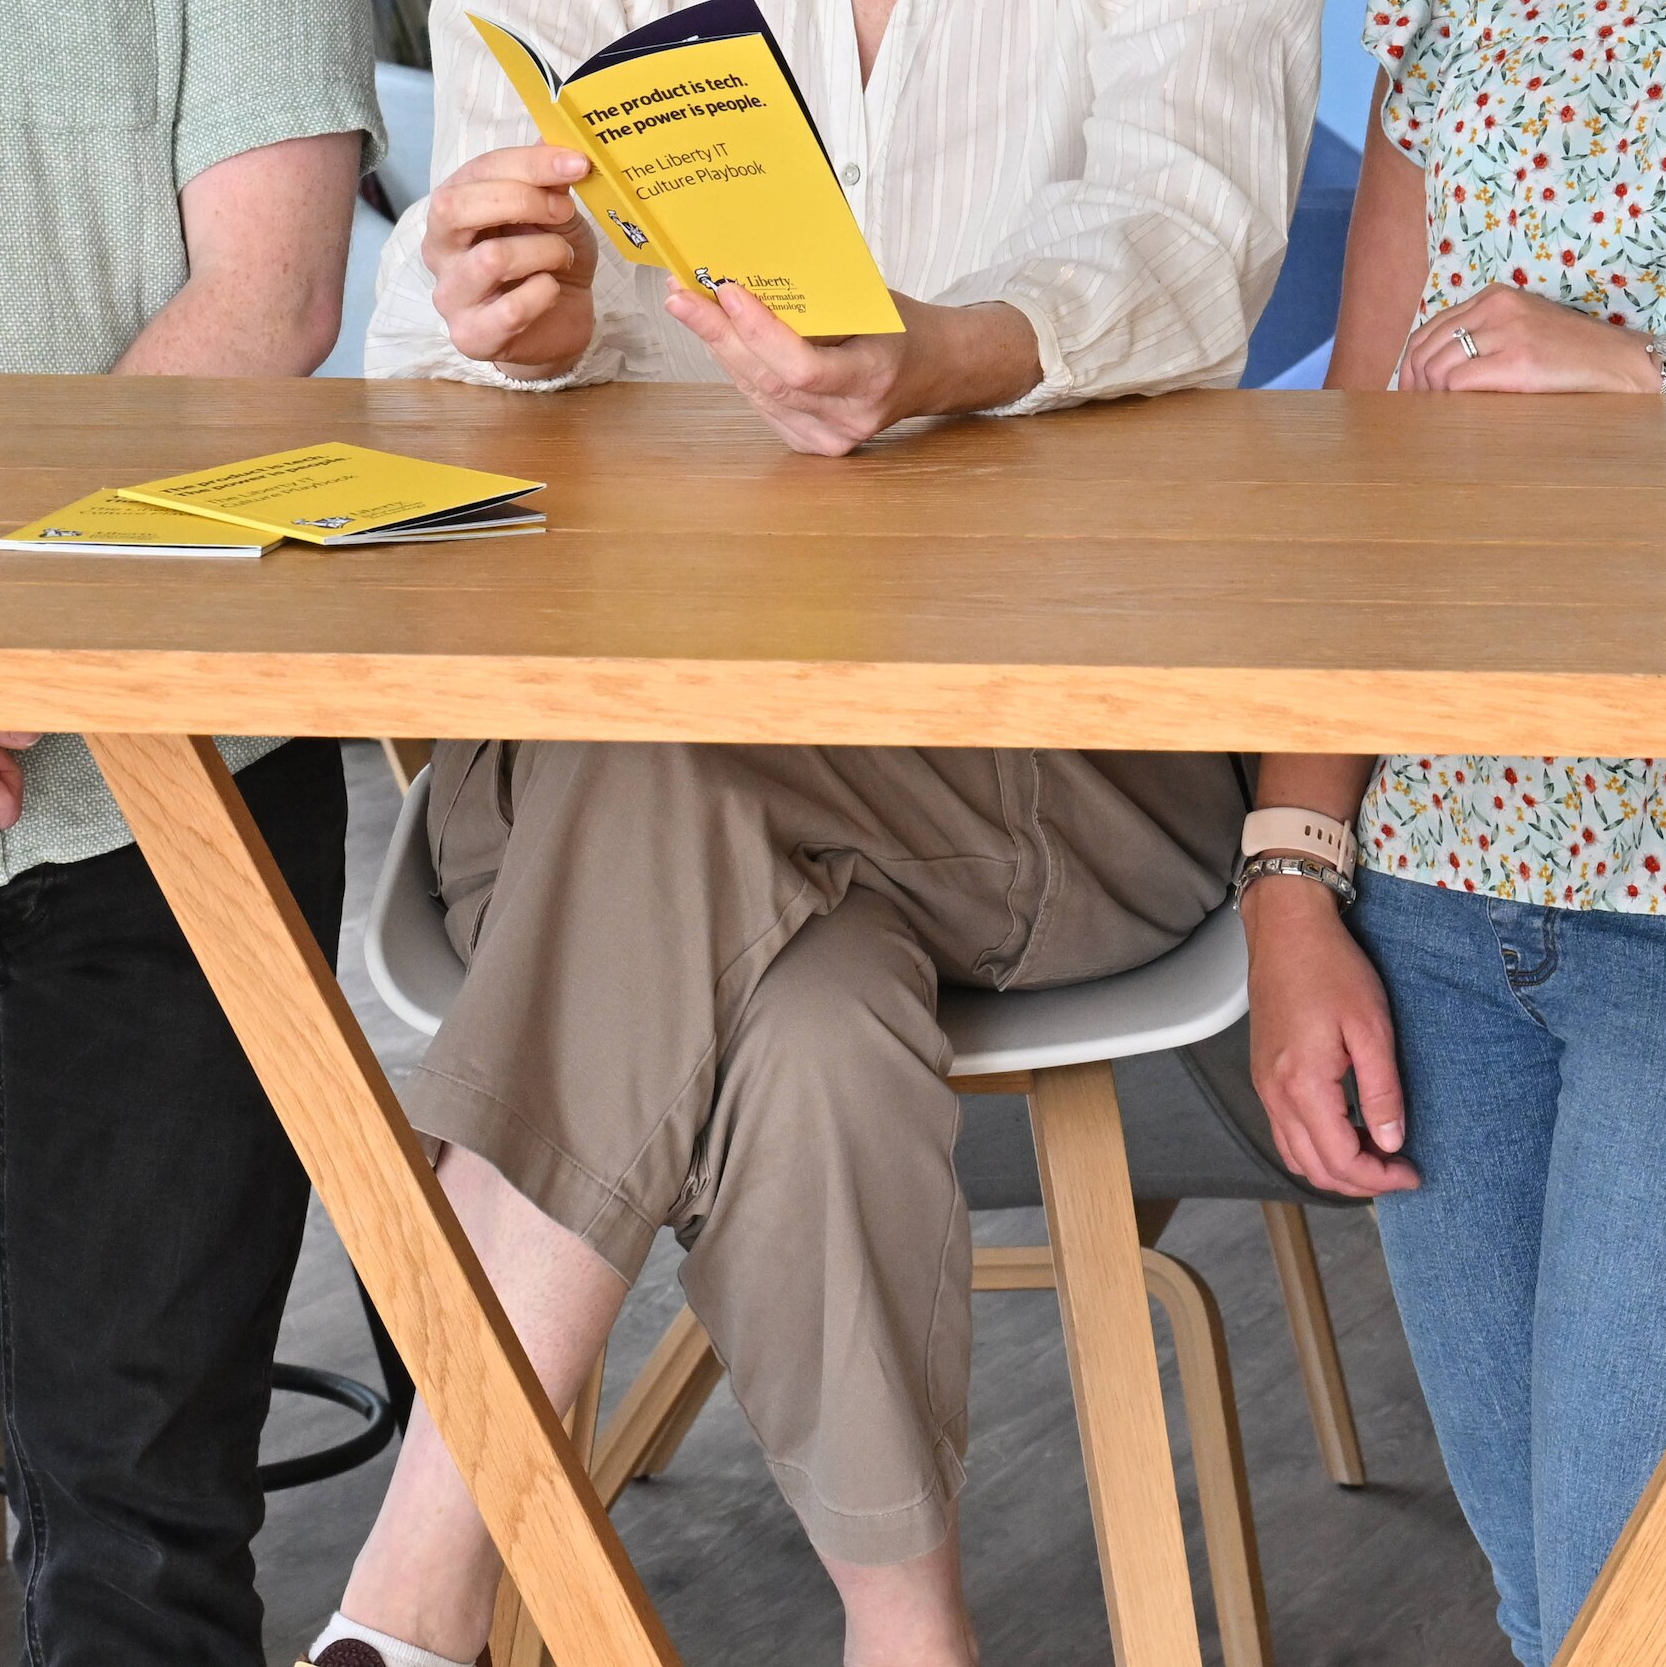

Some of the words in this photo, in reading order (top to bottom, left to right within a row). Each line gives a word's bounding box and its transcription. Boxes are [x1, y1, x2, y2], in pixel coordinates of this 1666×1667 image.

[582, 105, 620, 126] The
[620, 83, 690, 116] product
[688, 81, 706, 94] is
[705, 74, 748, 91] tech.
[595, 124, 633, 145] The
[633, 108, 687, 135] power
[687, 103, 705, 117] is
[705, 94, 767, 117] people.
[621, 163, 656, 182] The
[655, 148, 712, 171] Liberty
[713, 142, 729, 157] IT
[635, 175, 696, 201] Culture
[695, 160, 767, 183] Playbook
[746, 275, 791, 291] Liberty
[766, 301, 806, 313] chnology
